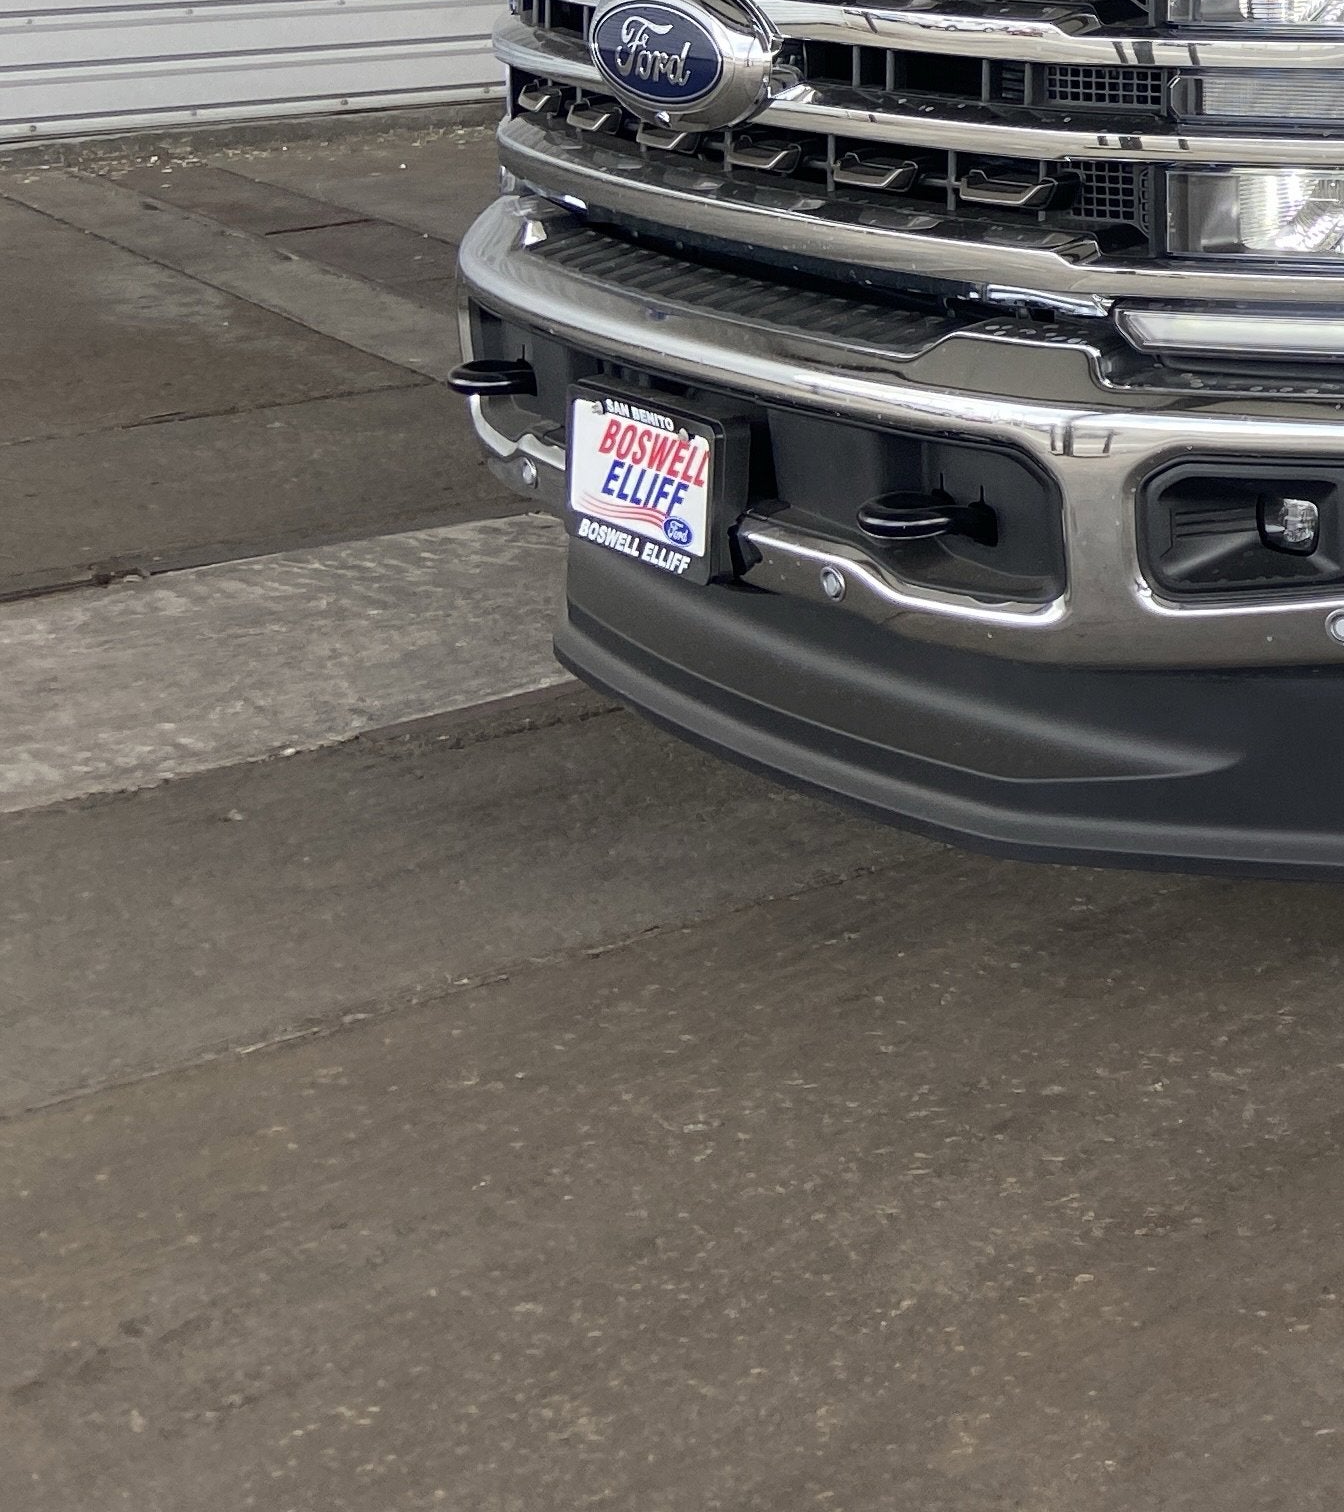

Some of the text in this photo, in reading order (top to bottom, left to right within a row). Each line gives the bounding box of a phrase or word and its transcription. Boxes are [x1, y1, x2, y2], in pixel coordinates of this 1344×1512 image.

[615, 16, 691, 86] Ford
[605, 399, 674, 432] SAN BENITO
[598, 419, 711, 487] BOSWELL
[601, 459, 689, 517] ELLIFF
[578, 518, 691, 574] BOSWELL ELLIFF
[667, 521, 692, 544] Ford
